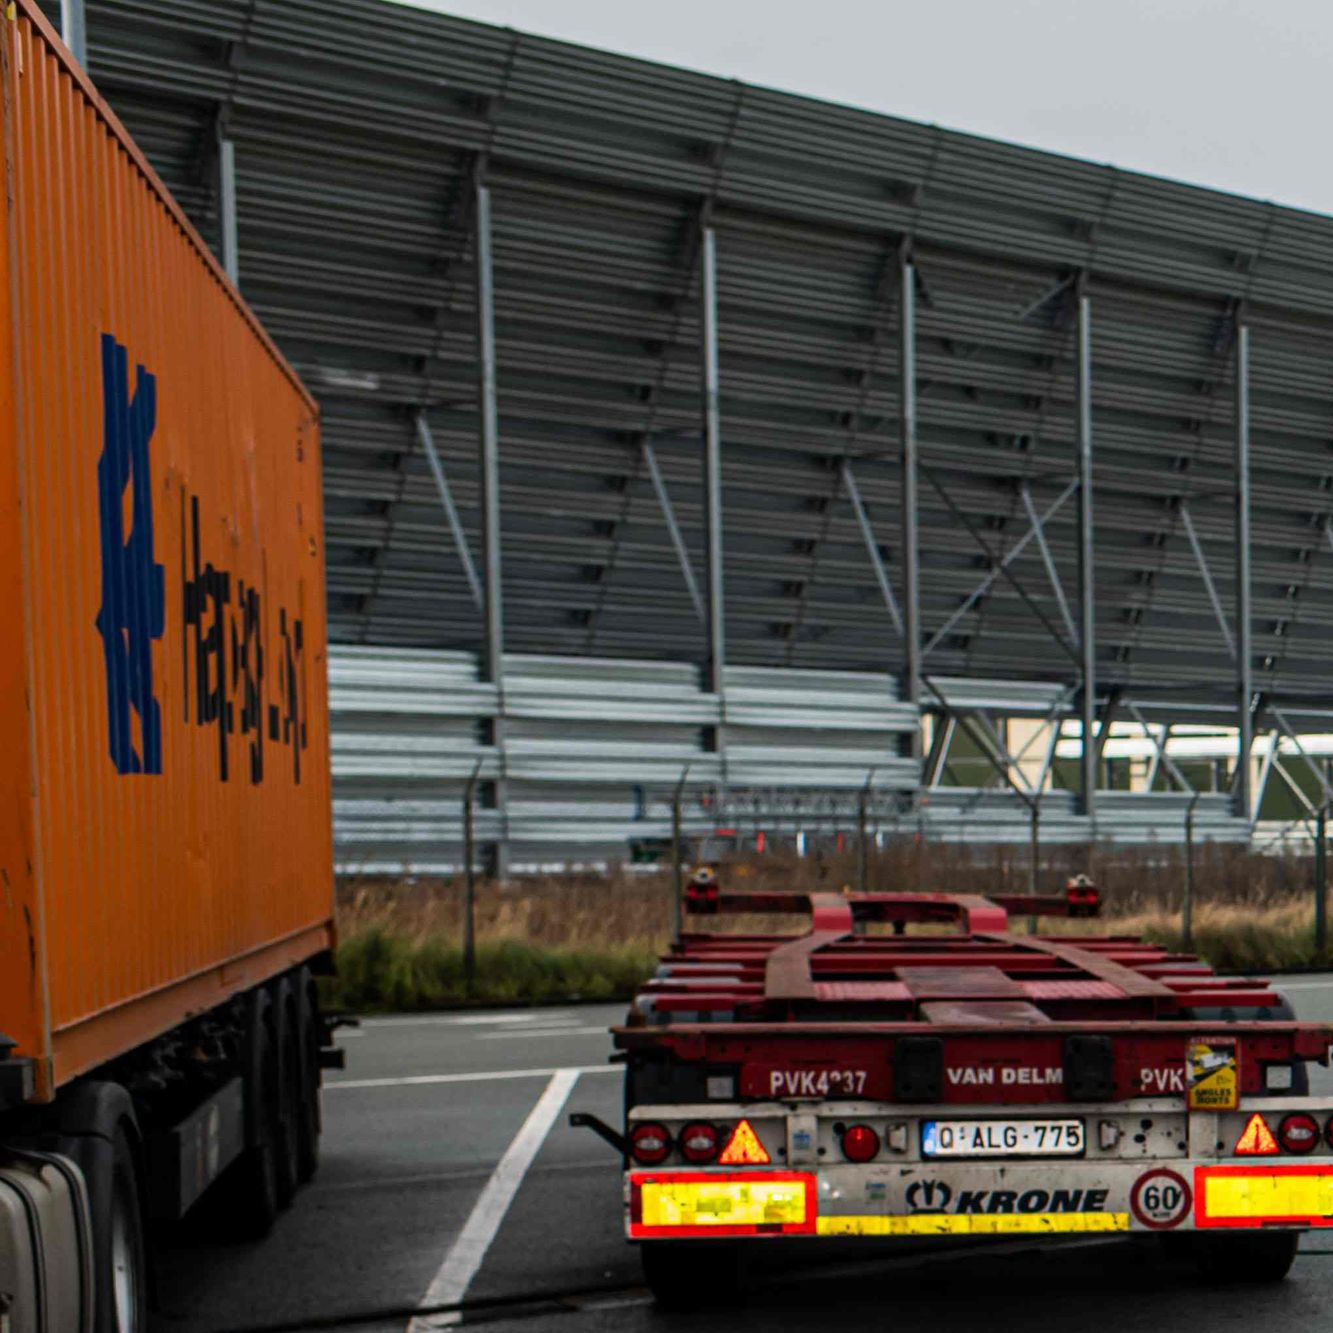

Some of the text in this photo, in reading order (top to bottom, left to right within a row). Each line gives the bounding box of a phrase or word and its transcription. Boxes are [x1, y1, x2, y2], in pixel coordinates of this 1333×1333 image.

[947, 1067, 994, 1085] VAN
[954, 1188, 1110, 1214] KRONE
[1143, 1185, 1179, 1211] 60
